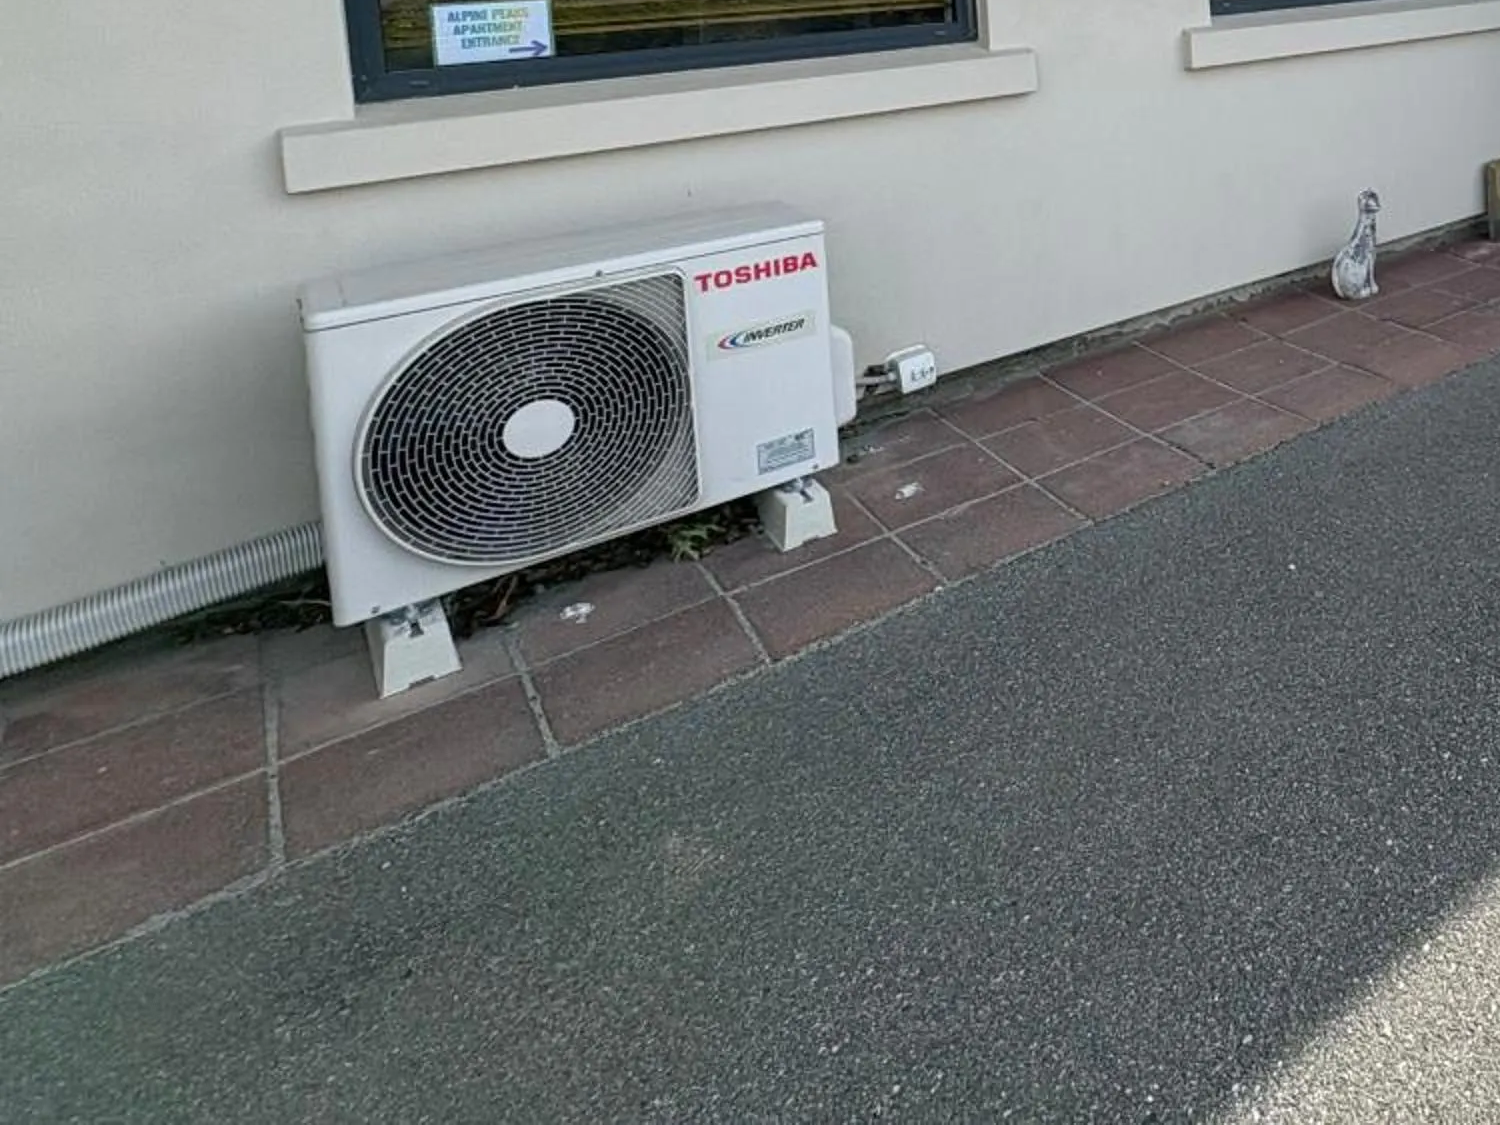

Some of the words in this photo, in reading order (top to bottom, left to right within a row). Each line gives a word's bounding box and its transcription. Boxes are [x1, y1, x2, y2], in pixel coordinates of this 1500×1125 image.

[453, 21, 523, 35] APARTMENT
[461, 35, 520, 48] ENTRANCE
[694, 252, 818, 292] TOSHIBA
[743, 318, 805, 343] INVERTER
